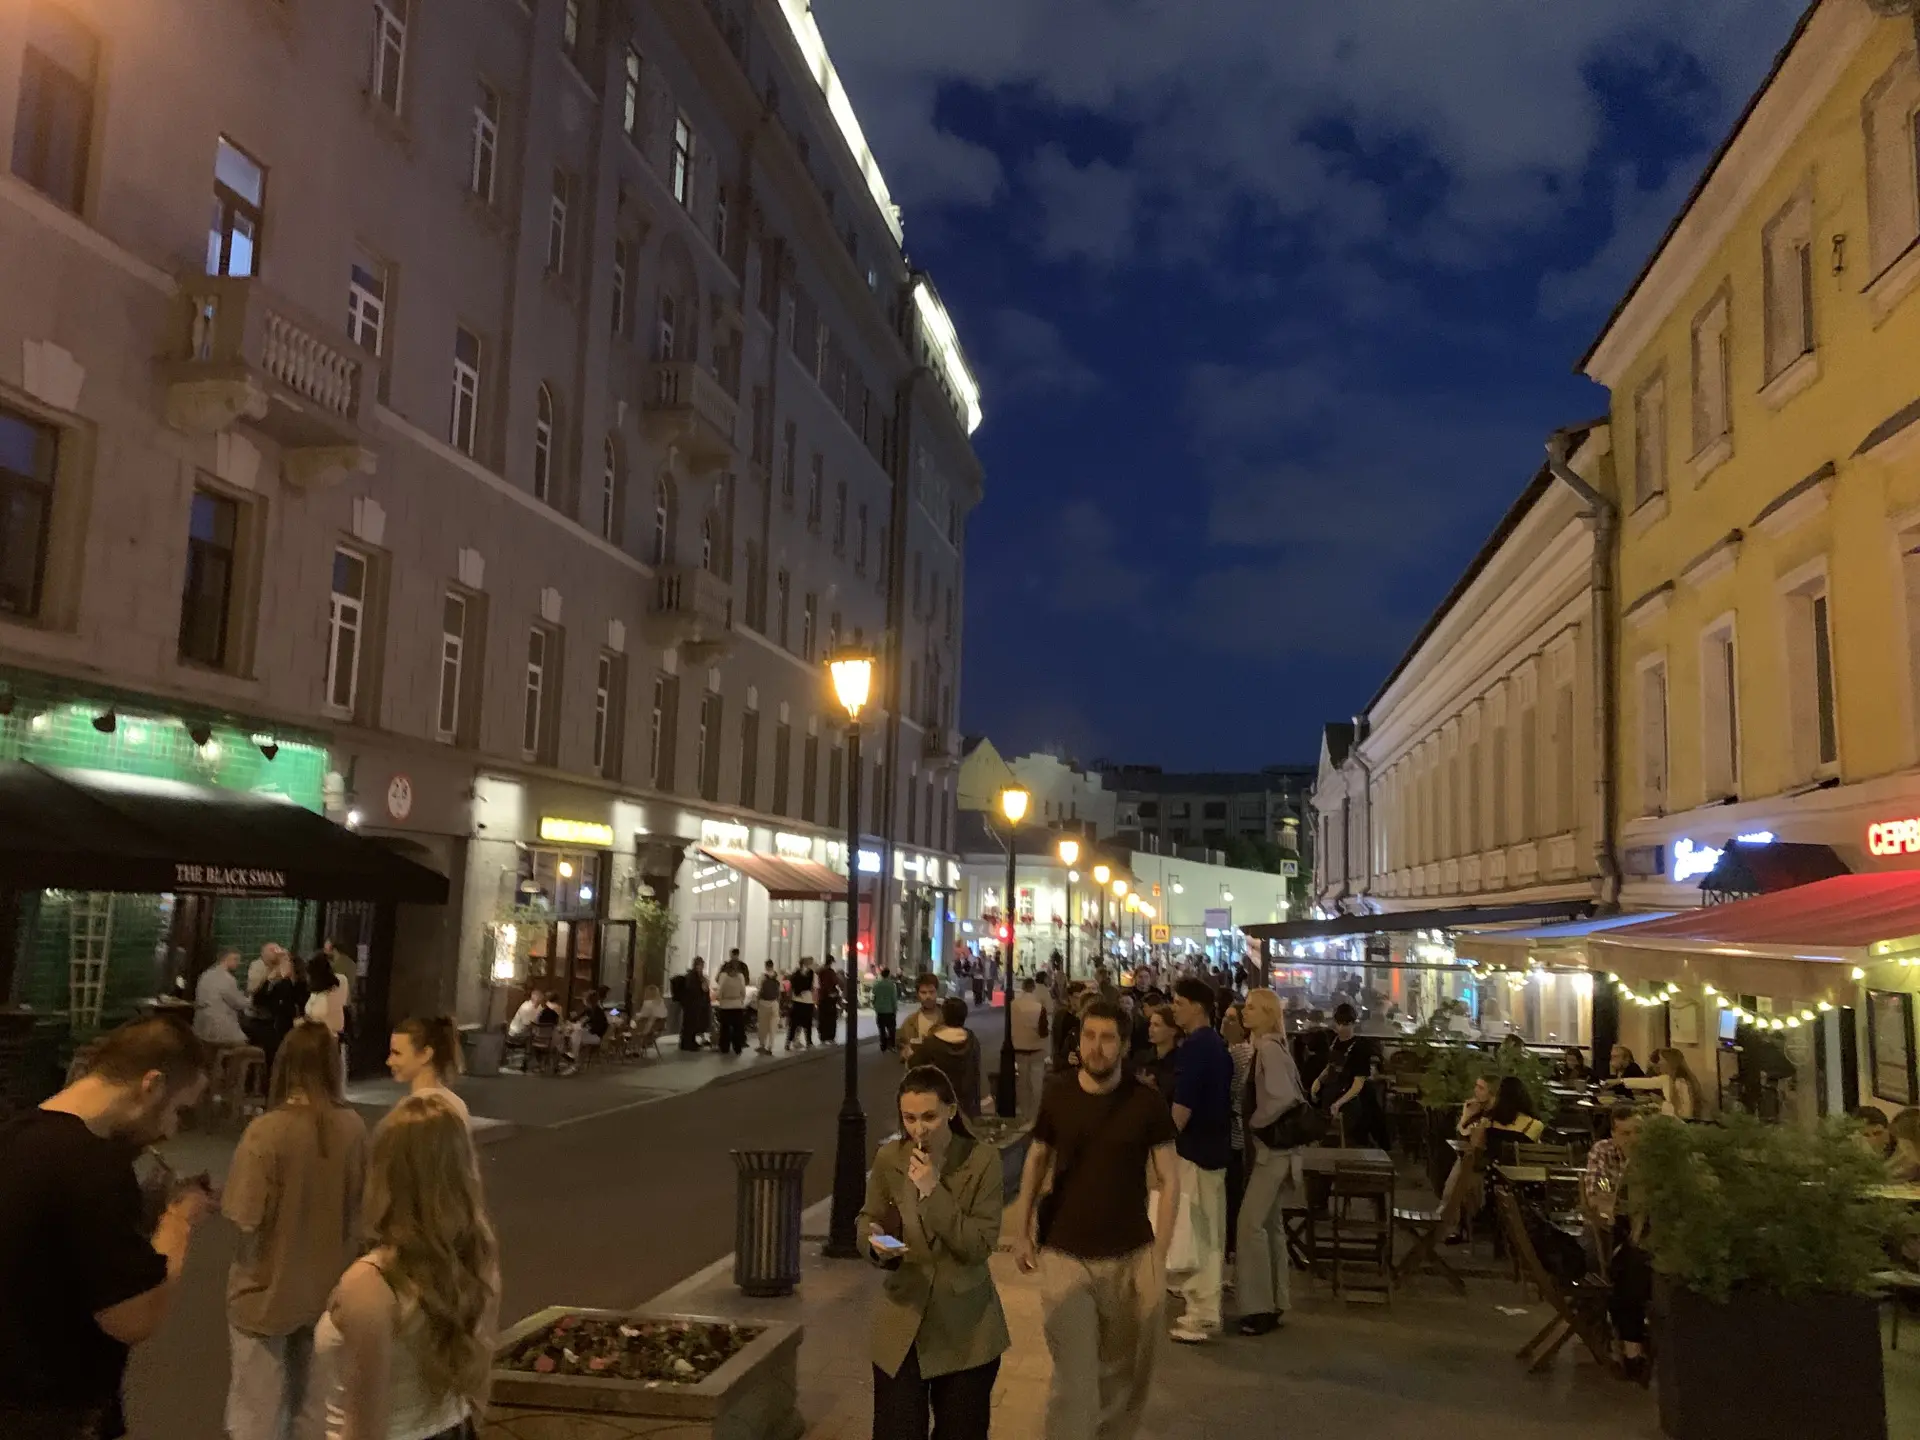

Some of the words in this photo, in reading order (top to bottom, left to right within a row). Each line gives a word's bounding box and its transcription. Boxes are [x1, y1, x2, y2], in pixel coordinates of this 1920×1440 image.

[1868, 817, 1920, 856] СЕРВ
[175, 864, 204, 882] THE
[206, 867, 247, 886] BLACK
[248, 870, 285, 887] SWAN
